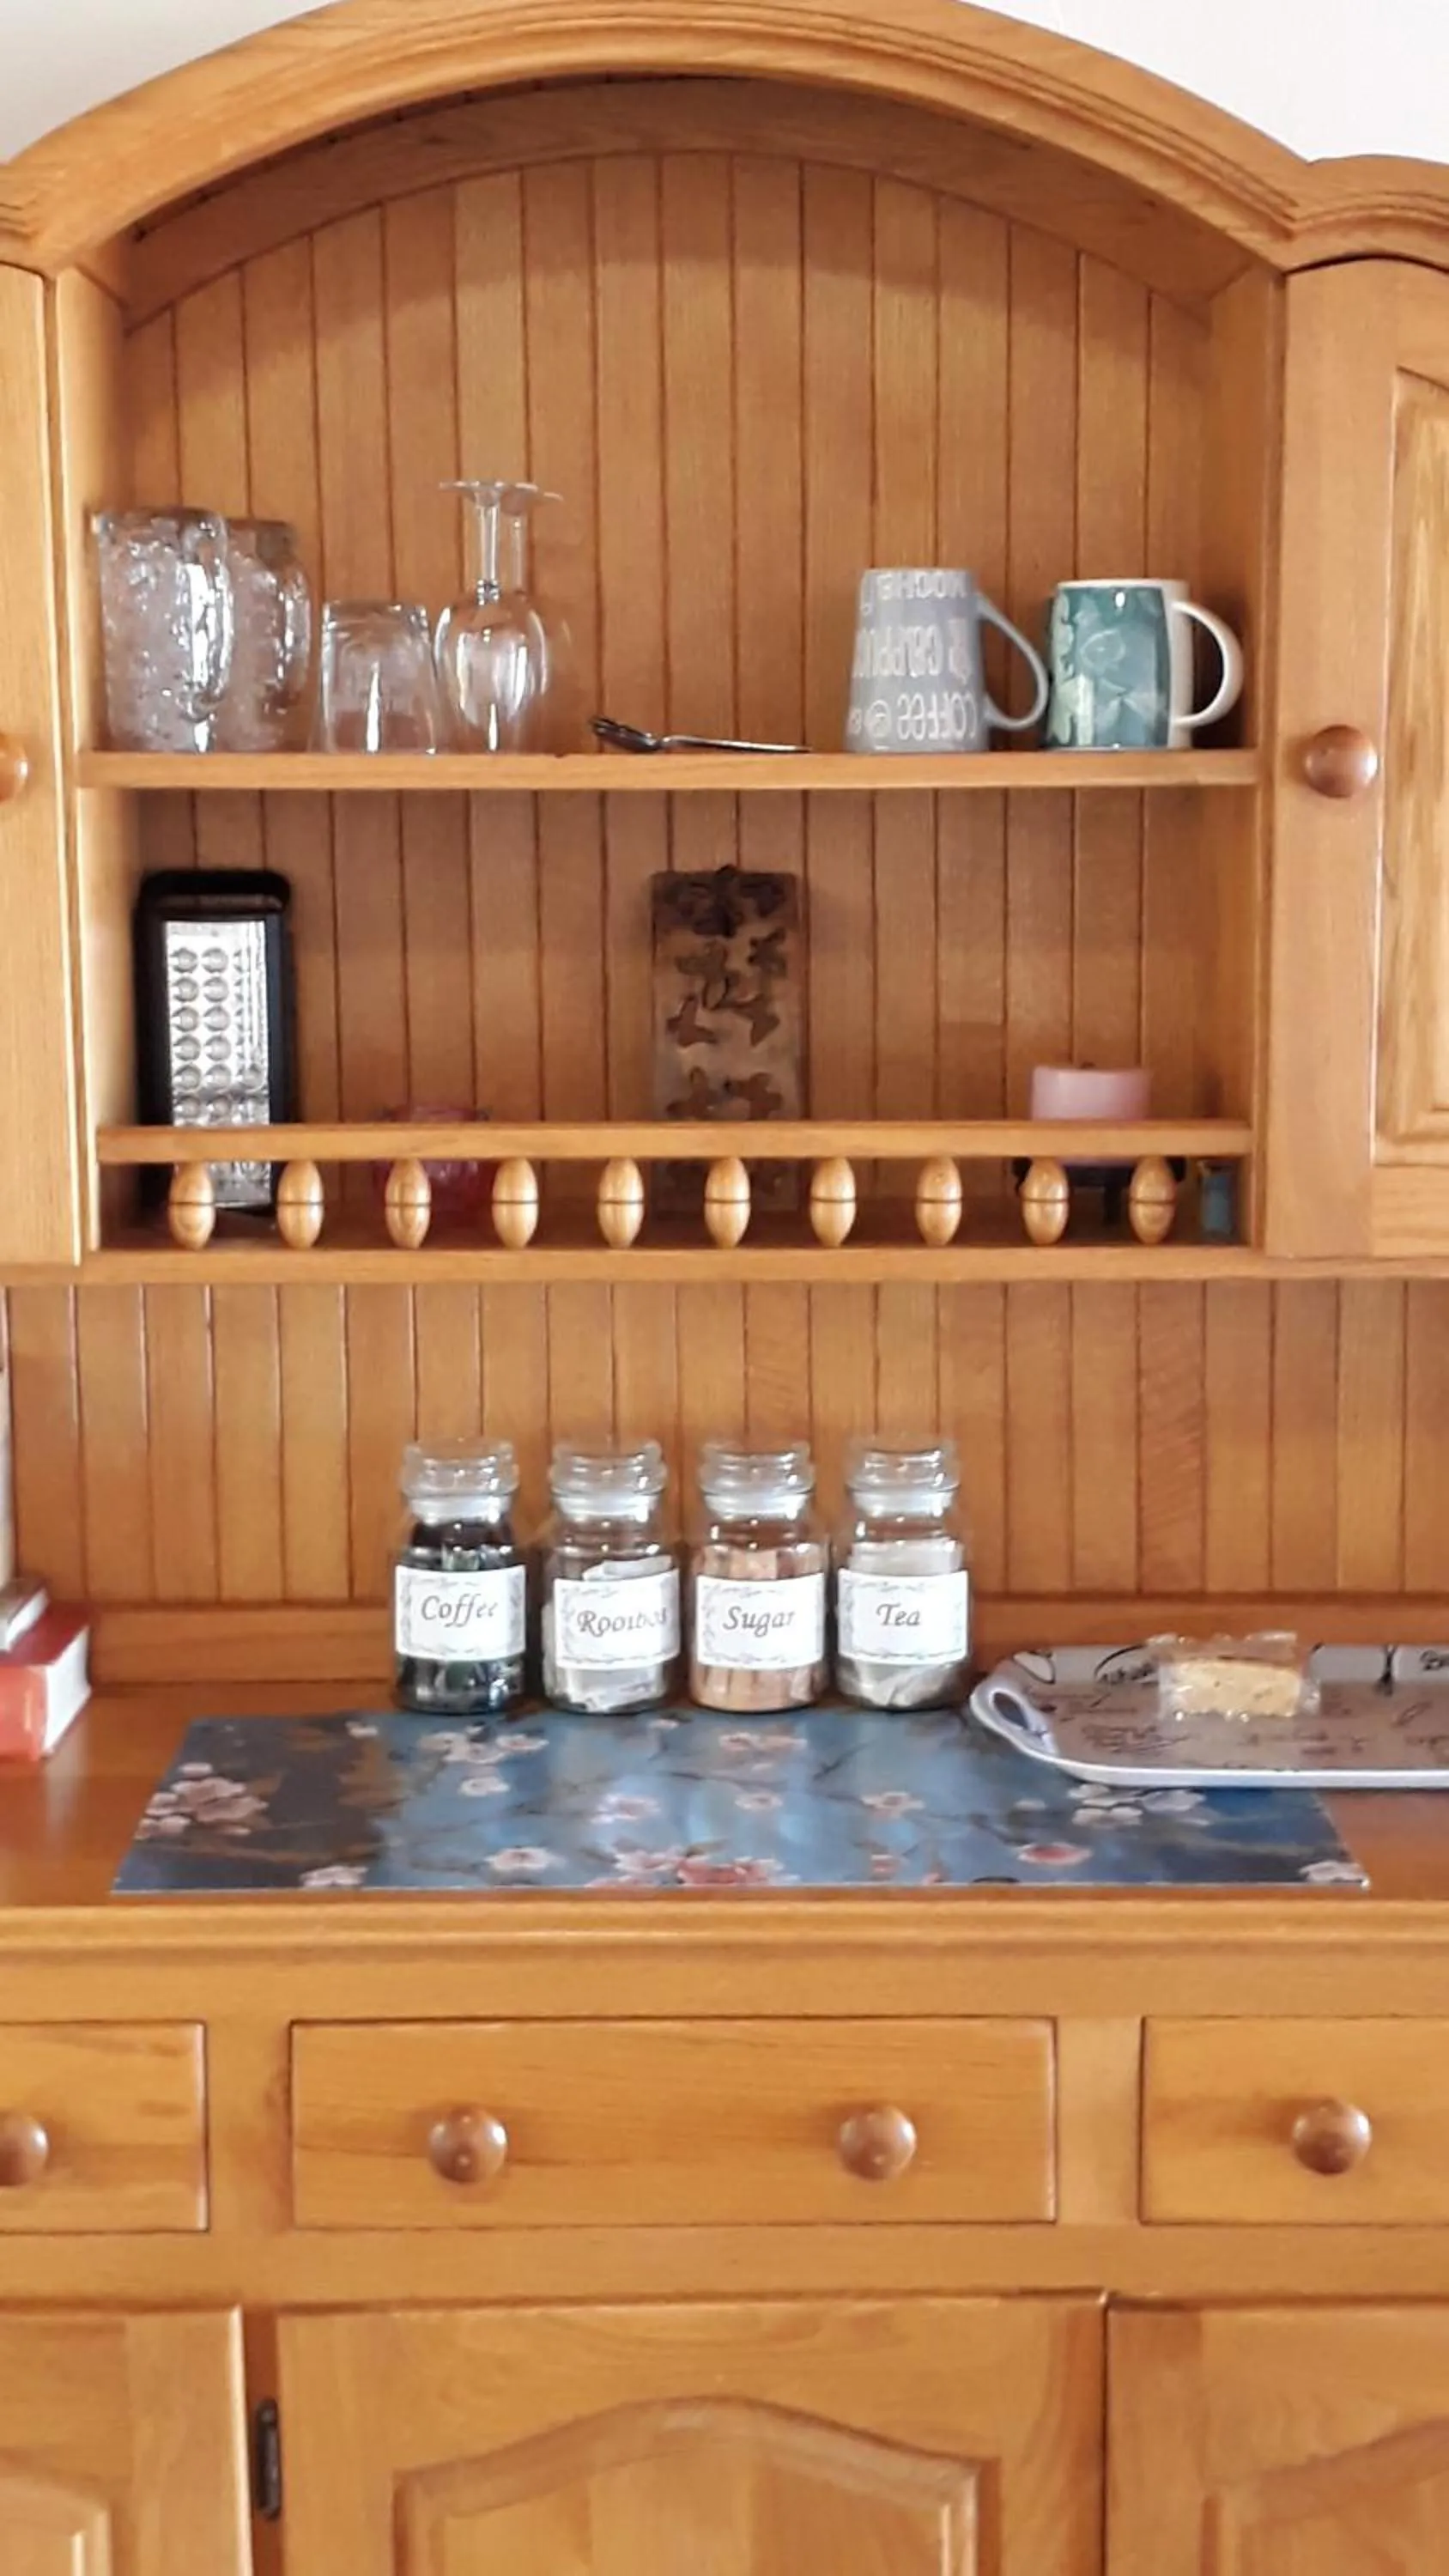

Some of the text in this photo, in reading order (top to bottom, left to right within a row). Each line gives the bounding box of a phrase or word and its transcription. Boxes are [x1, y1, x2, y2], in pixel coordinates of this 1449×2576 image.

[421, 1593, 499, 1628] Coffee
[723, 1605, 796, 1637] Sugar
[876, 1602, 921, 1626] Tea
